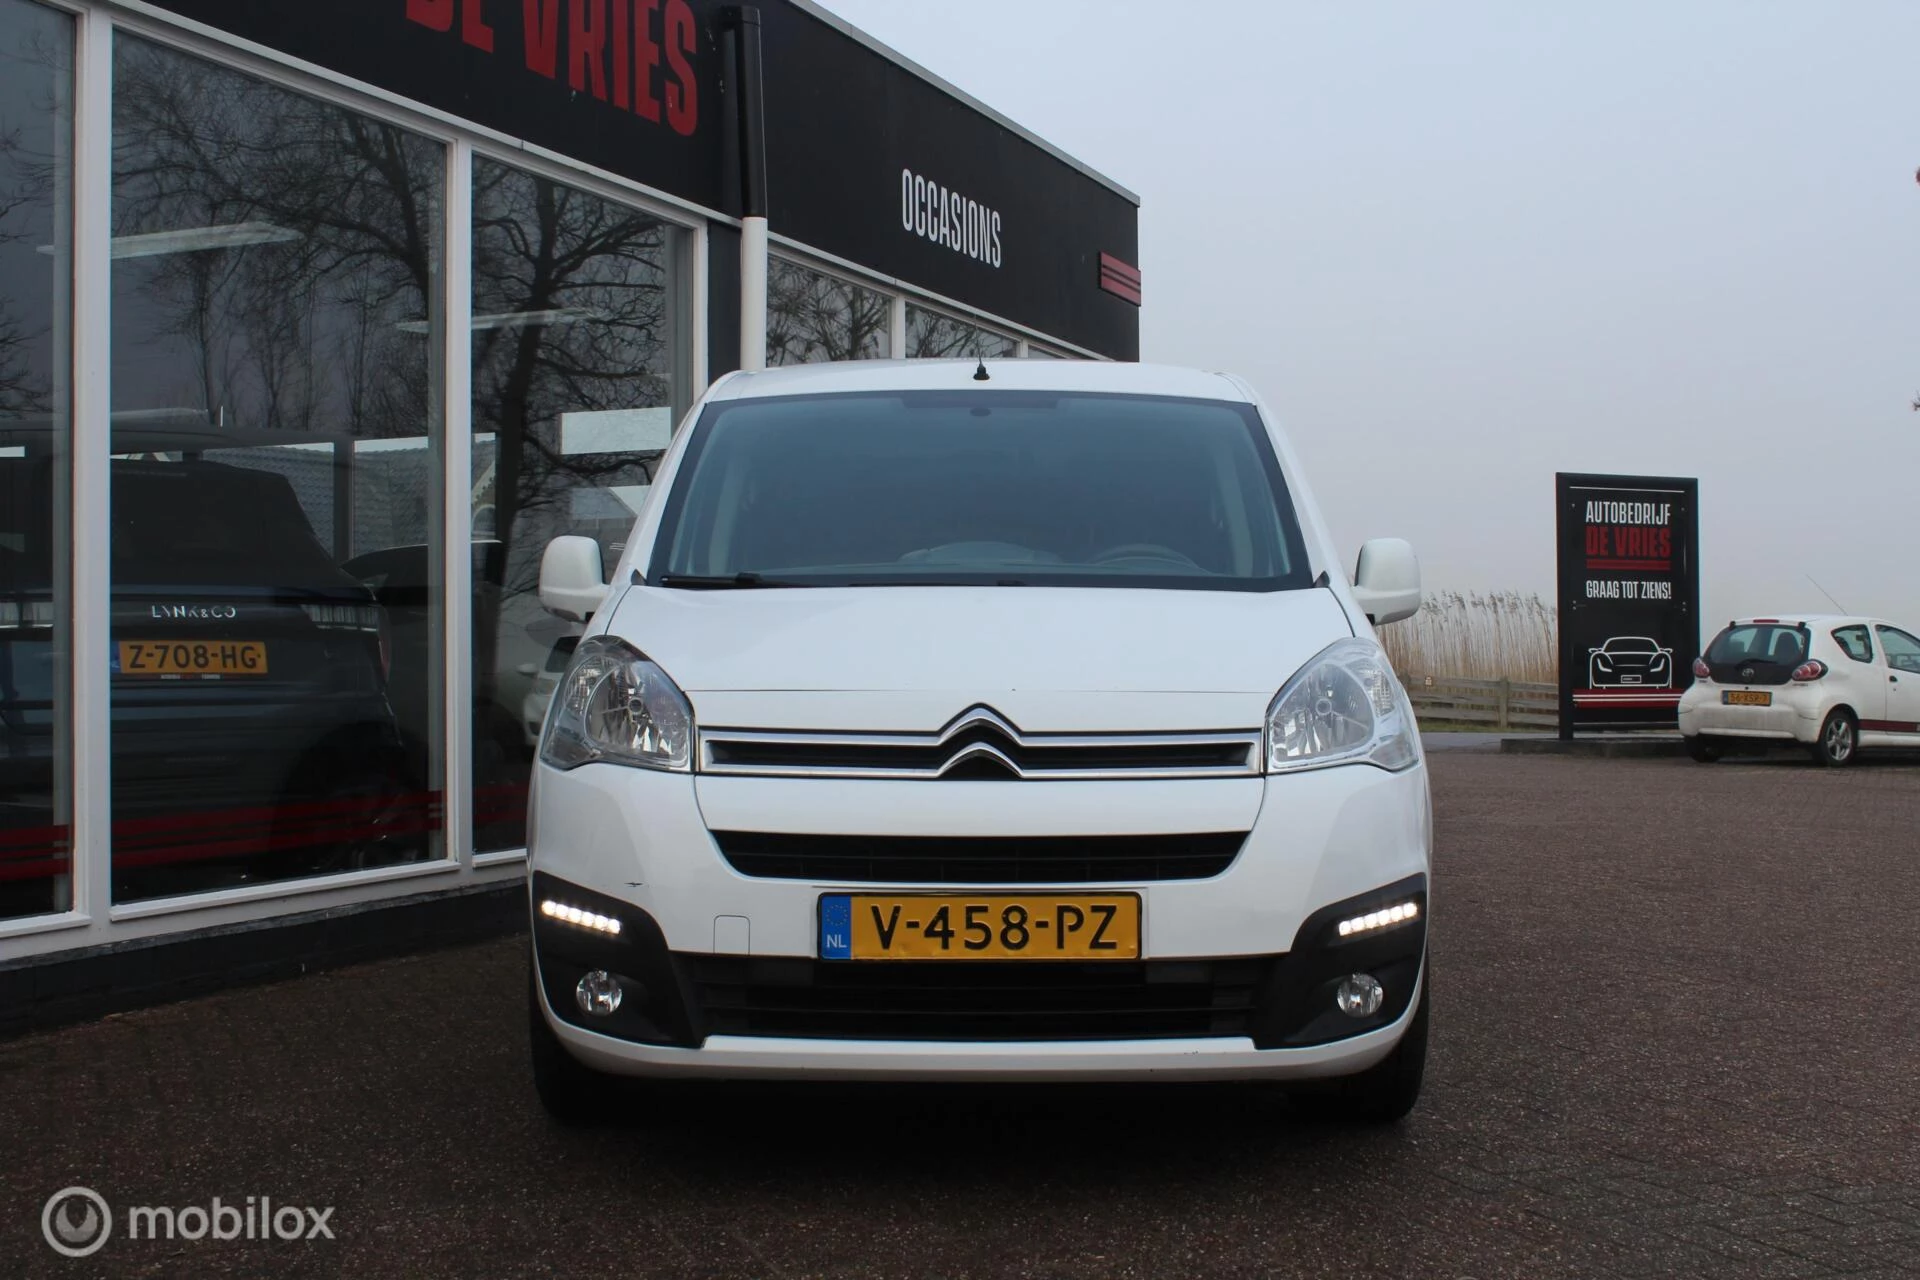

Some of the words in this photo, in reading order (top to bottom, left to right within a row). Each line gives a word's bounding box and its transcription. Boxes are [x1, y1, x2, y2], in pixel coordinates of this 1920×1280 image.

[901, 168, 1002, 269] OCCASIONS
[1585, 501, 1671, 525] AUTOBEDRIJF
[1585, 526, 1609, 556] DE
[1613, 527, 1672, 558] VRIES
[1586, 580, 1620, 598] GRAAG
[1621, 581, 1639, 599] TOT
[1640, 581, 1672, 600] ZIENS!
[129, 645, 258, 669] Z-708-HG
[870, 904, 1118, 951] V-458-PZ
[826, 934, 847, 949] NL
